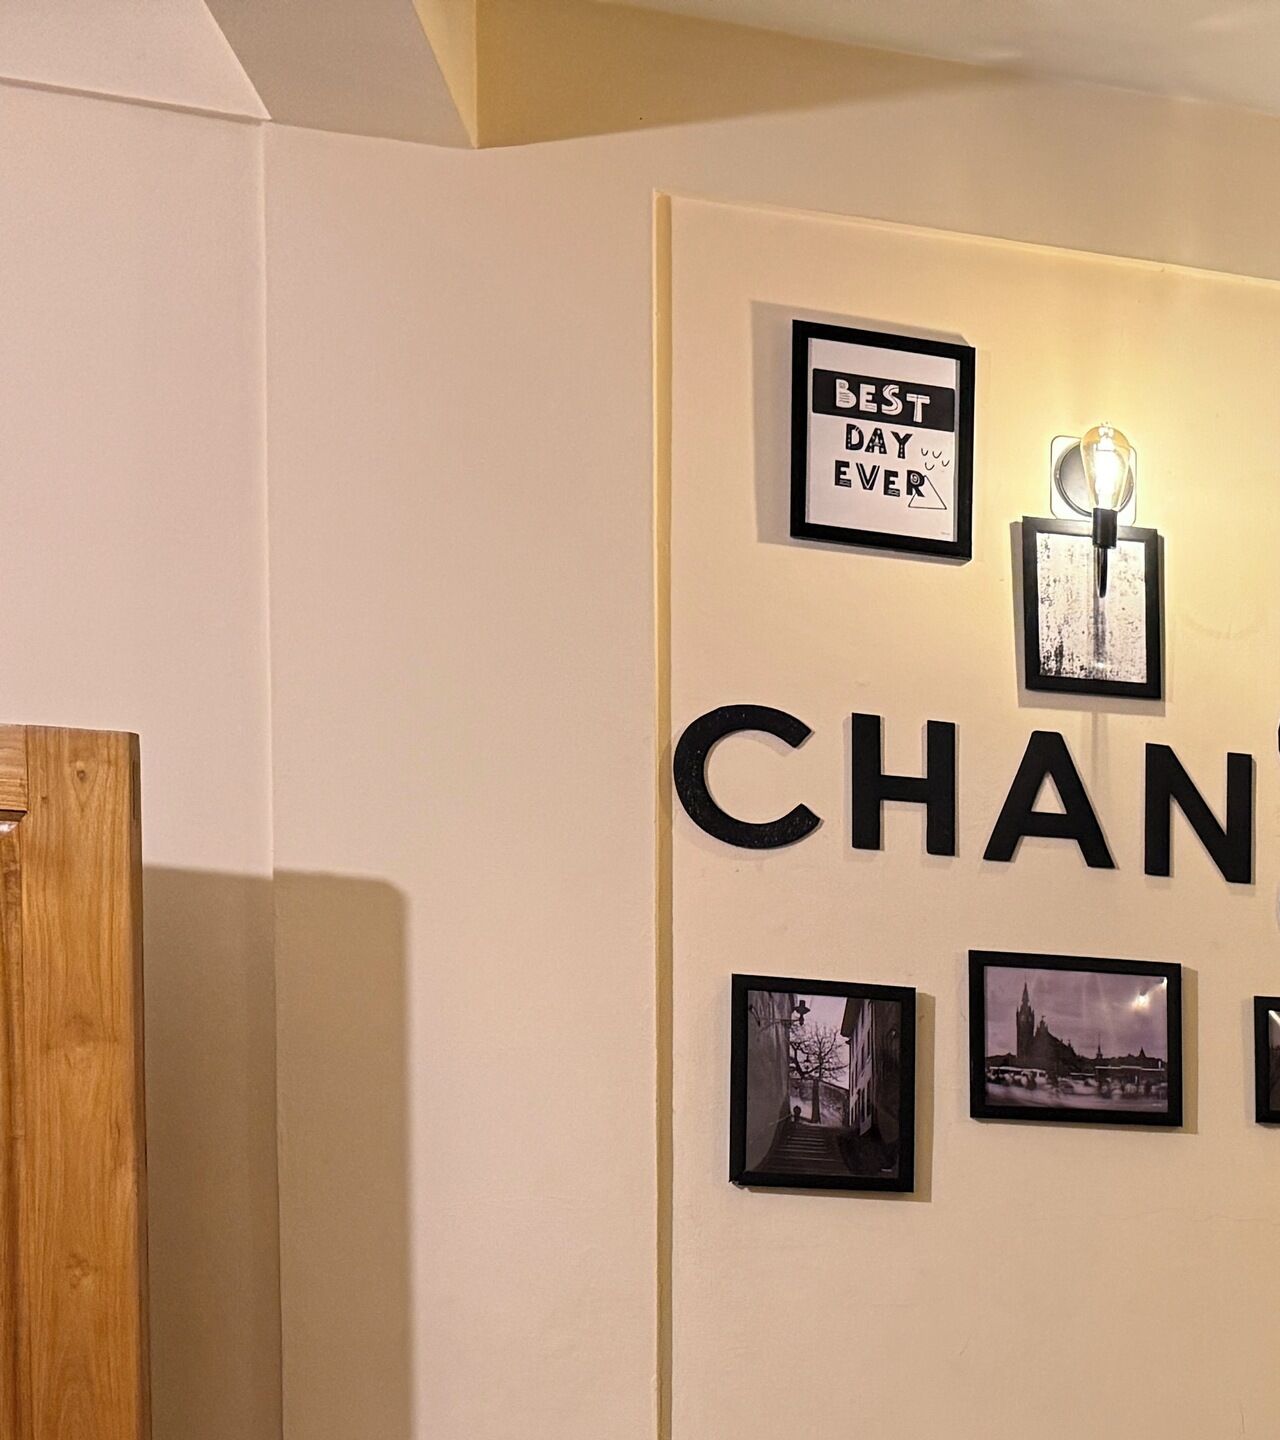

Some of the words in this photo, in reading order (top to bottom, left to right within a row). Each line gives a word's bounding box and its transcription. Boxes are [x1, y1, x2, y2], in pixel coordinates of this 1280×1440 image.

[836, 378, 931, 423] BEST
[845, 423, 913, 459] DAY
[834, 460, 925, 498] EVER
